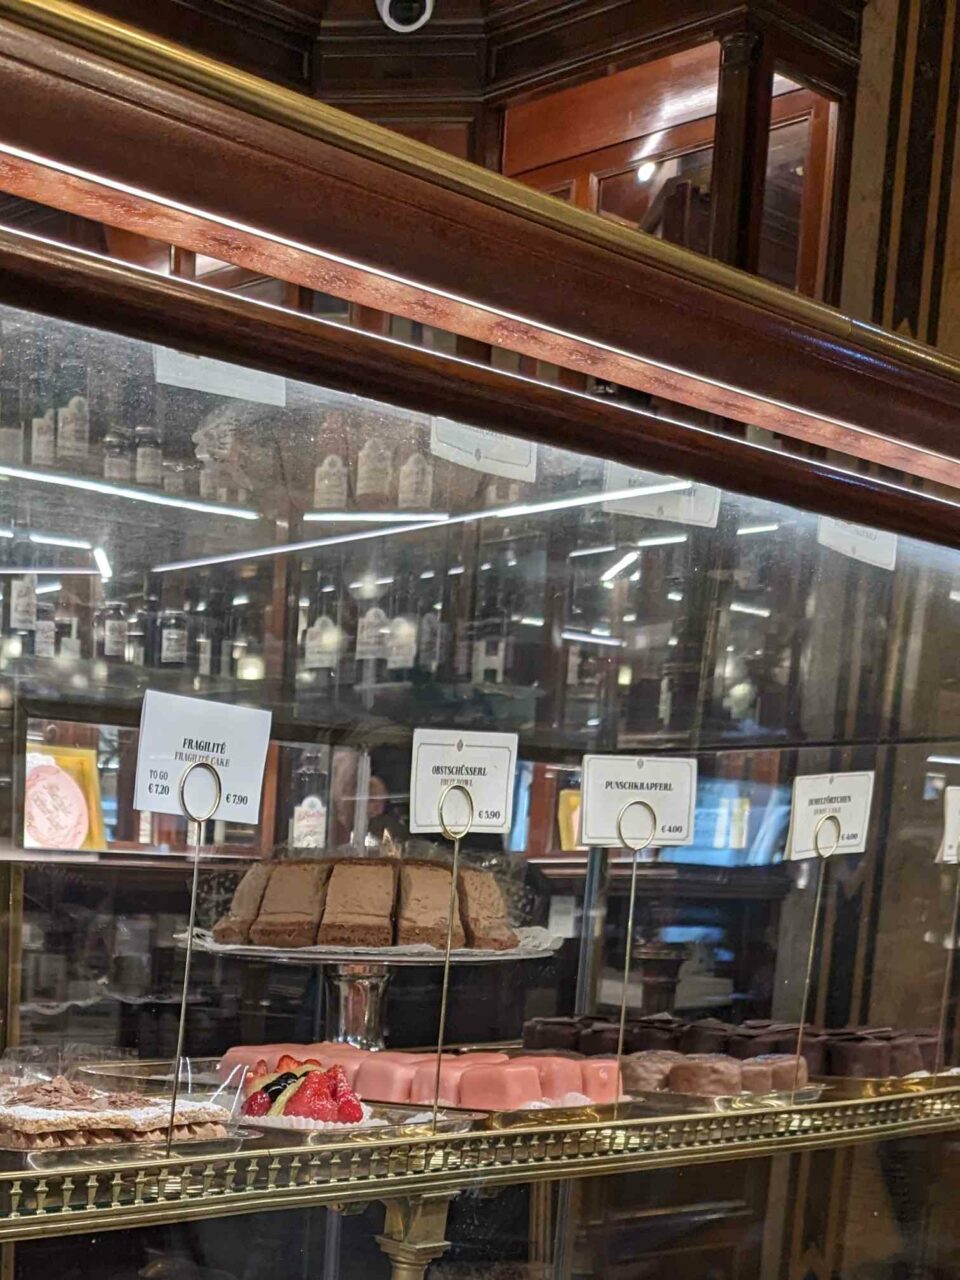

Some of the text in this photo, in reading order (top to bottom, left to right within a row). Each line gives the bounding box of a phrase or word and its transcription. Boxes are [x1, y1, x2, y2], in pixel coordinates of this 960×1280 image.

[182, 737, 227, 754] FRAGILITÉ
[210, 757, 231, 768] CAKE
[149, 769, 168, 780] TO GO
[431, 764, 488, 777] OBSTSCHÜSSERL
[605, 780, 673, 792] PUNSCHKRAPFERL
